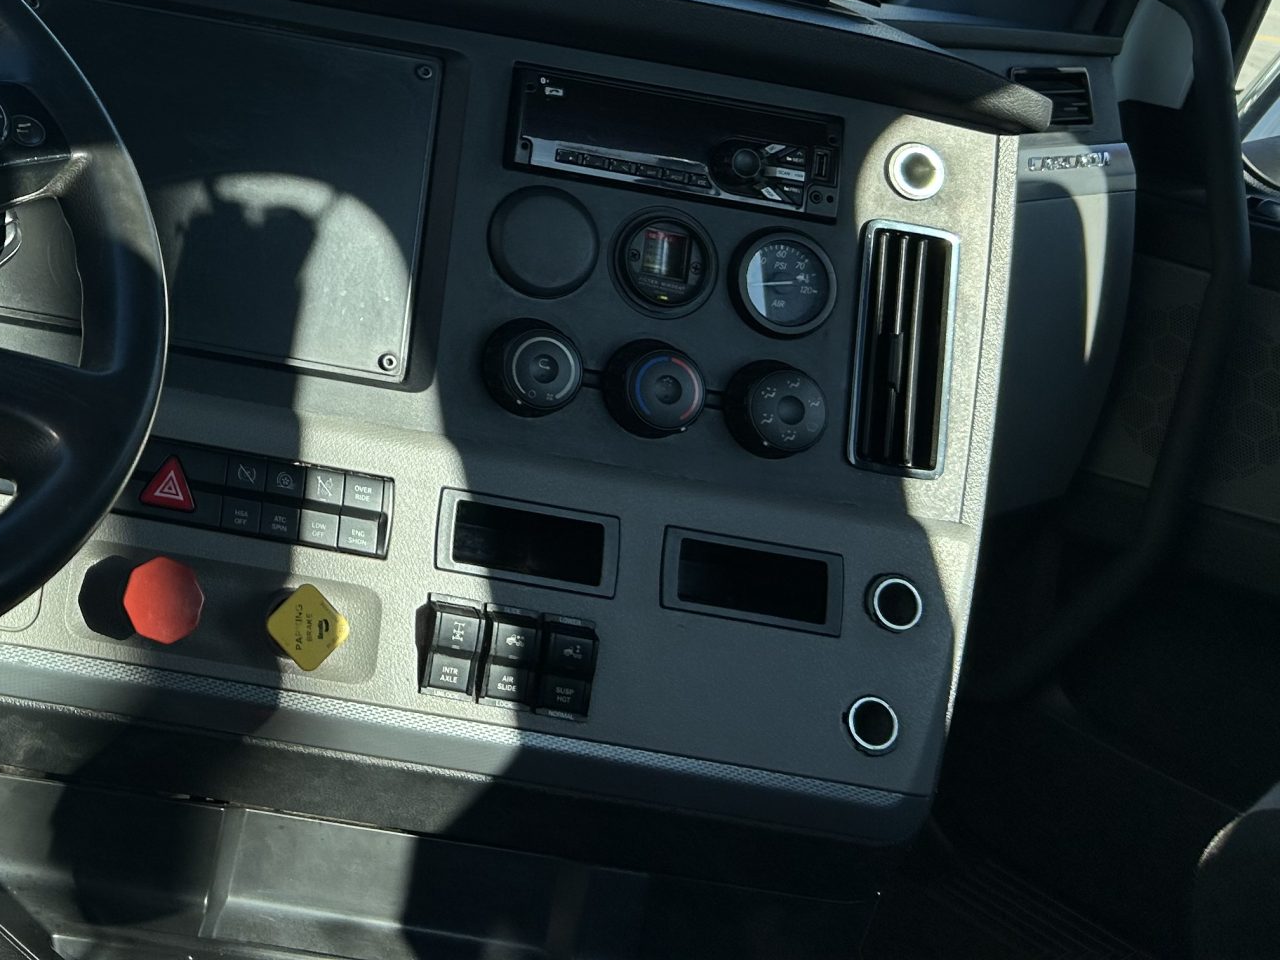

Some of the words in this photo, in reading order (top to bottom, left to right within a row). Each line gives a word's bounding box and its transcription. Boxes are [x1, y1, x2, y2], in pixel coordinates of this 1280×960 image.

[774, 261, 788, 270] PSI
[771, 299, 786, 308] AIR
[354, 485, 372, 494] OVER
[354, 493, 370, 502] RIDE
[274, 515, 287, 524] ATC
[351, 529, 365, 538] ENG
[442, 666, 459, 675] INTR
[440, 674, 458, 684] AXLE
[502, 675, 514, 684] AIR
[497, 682, 516, 692] SLIDE
